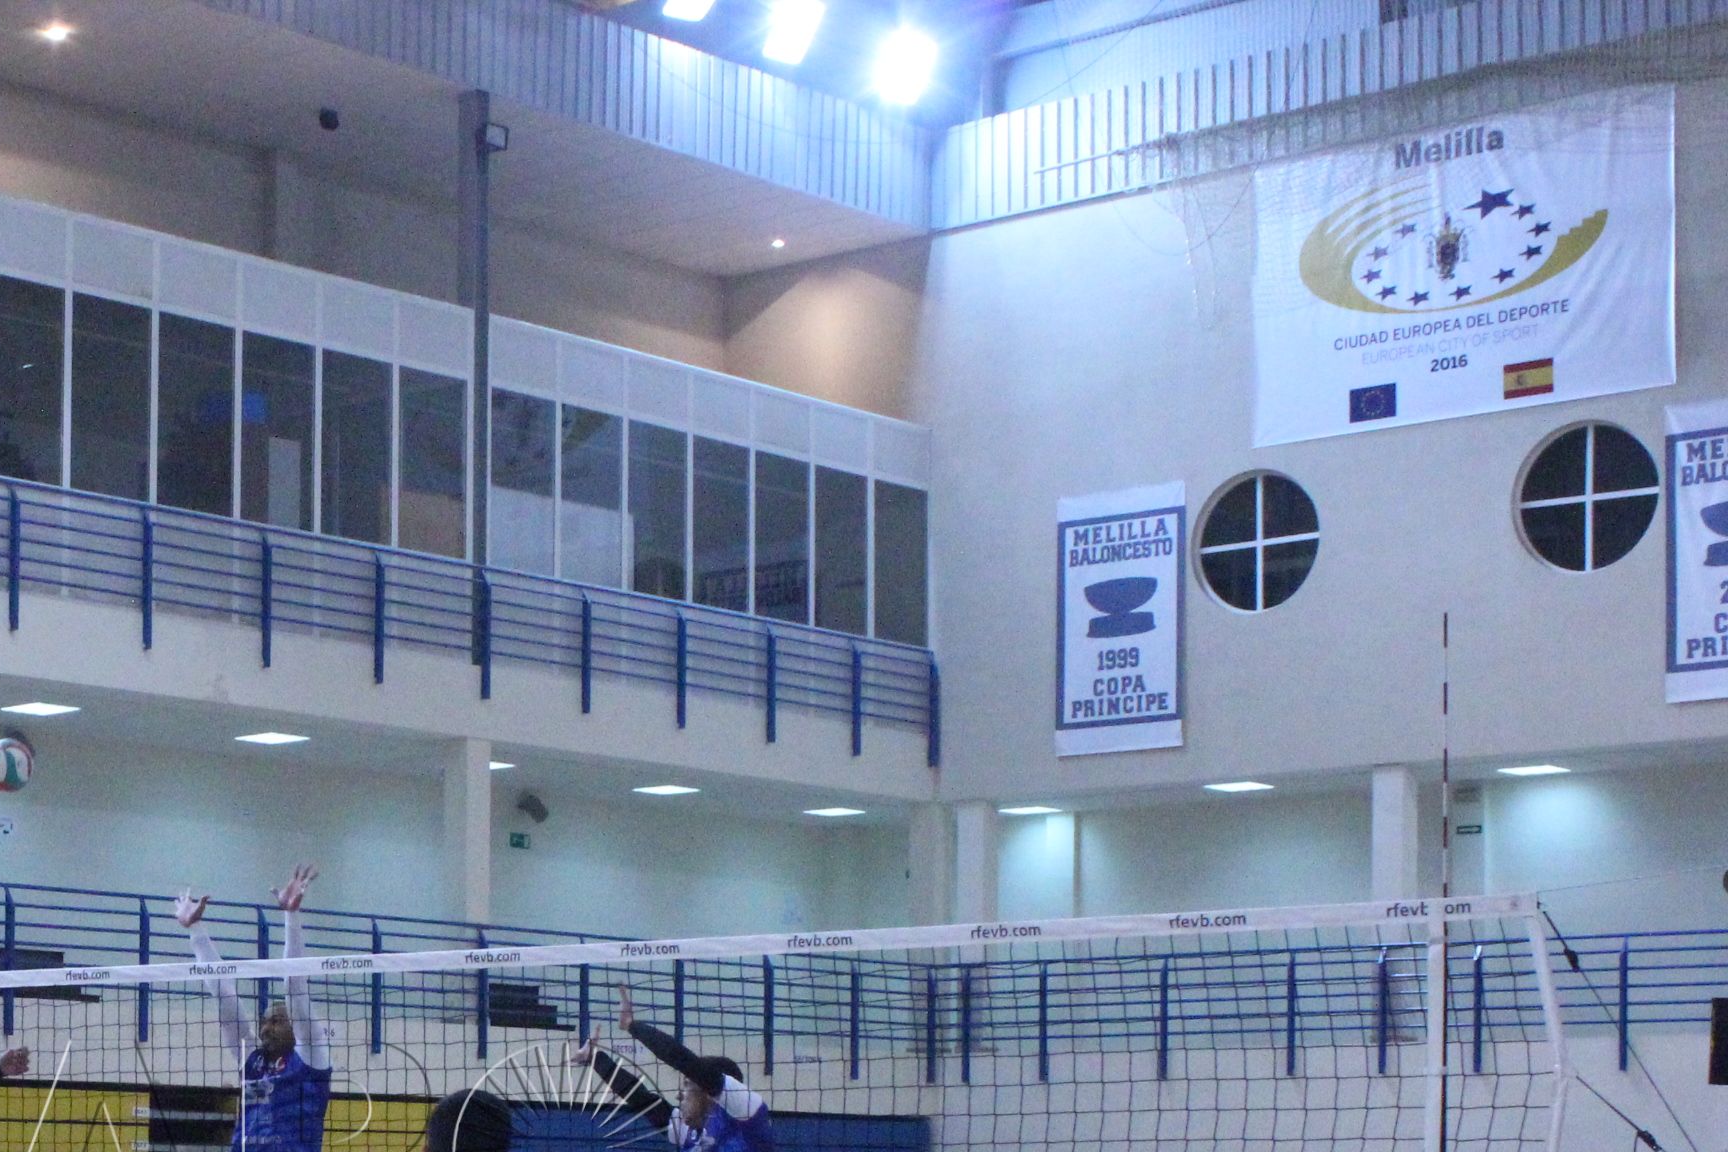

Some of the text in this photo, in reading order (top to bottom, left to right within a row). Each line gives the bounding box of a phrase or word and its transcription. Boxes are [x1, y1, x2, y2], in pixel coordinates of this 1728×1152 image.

[1395, 126, 1505, 170] Melilla
[1334, 299, 1570, 351] CIUDAD EUROPEA DEL DEPORTE
[1362, 324, 1538, 366] EUROPEAN CITY OF SPORT
[1430, 355, 1469, 373] 2016
[1073, 518, 1169, 547] MELILLA
[1069, 538, 1173, 568] BALONCESTO
[1097, 647, 1140, 671] 1999
[1093, 675, 1147, 697] COPA
[1071, 692, 1169, 719] PRINCIPE
[1169, 912, 1247, 930] rfevb.com
[971, 924, 1042, 940] rfevb.com
[621, 942, 680, 957] rfevb.com
[787, 934, 853, 949] rfevb.com
[321, 957, 374, 971] rfevb.com
[465, 950, 521, 965] rfevb.com
[65, 970, 111, 982] rfevb.com
[189, 963, 237, 977] rfevb.com
